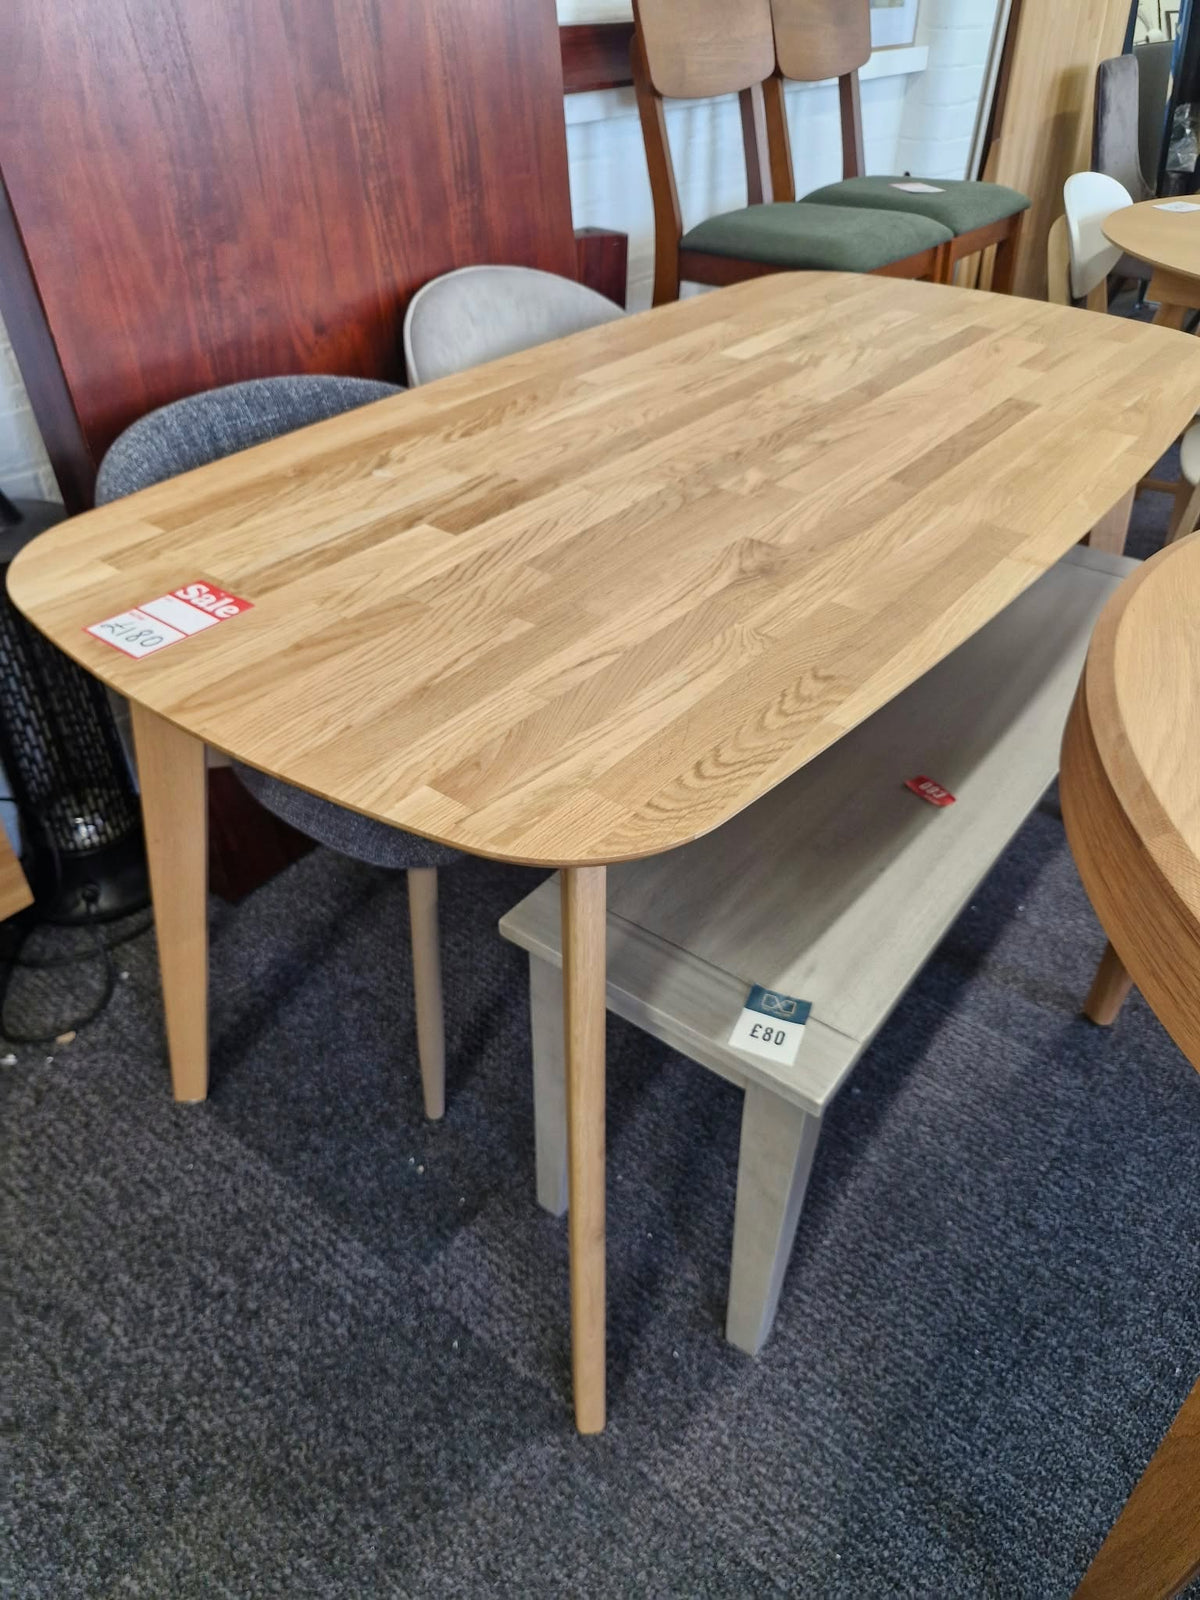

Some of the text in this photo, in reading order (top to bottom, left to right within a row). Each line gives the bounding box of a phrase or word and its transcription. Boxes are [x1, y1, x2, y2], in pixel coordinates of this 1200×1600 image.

[174, 583, 240, 618] Sale
[100, 621, 164, 648] £180
[749, 1023, 786, 1046] £80
